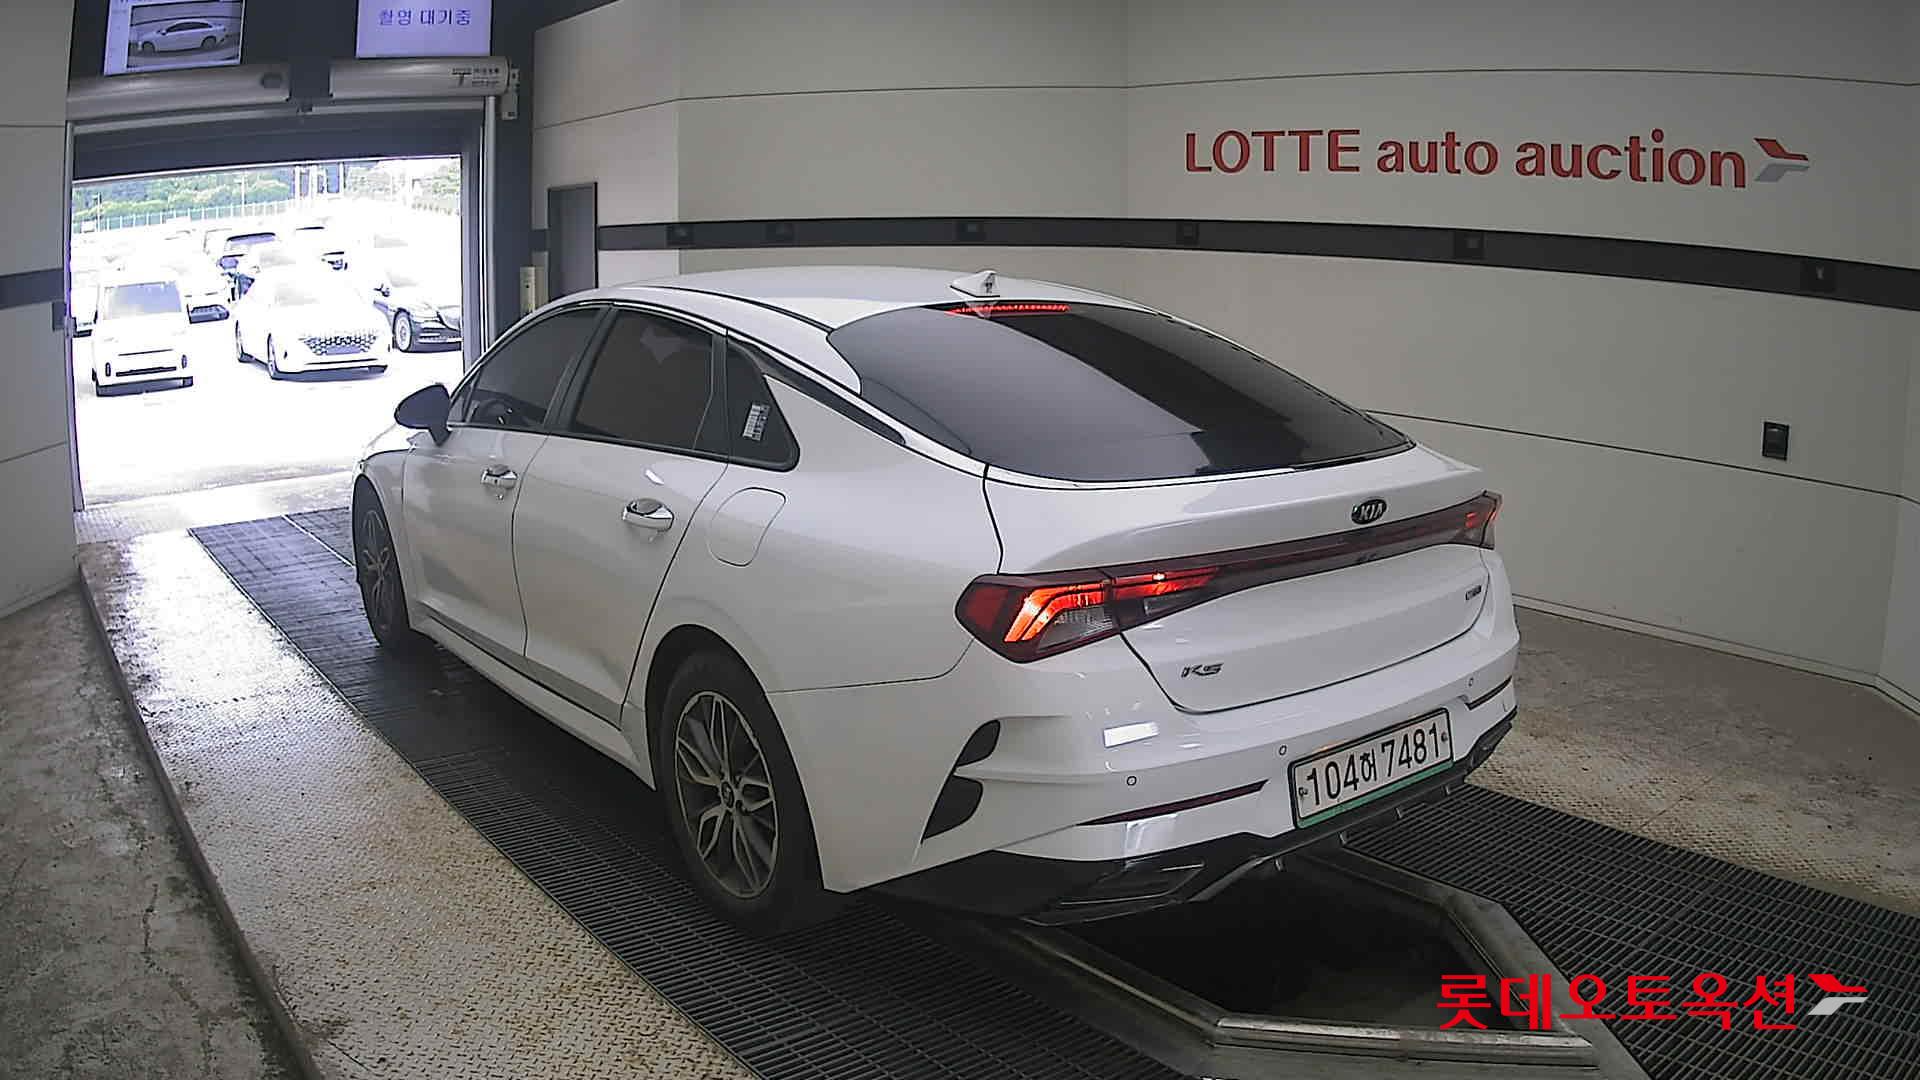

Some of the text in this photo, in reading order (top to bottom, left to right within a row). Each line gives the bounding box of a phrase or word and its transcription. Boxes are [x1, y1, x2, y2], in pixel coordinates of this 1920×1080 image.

[420, 8, 471, 26] 대기중
[1186, 129, 1746, 188] LOTTE auto auction
[1357, 502, 1385, 522] KIA
[1180, 663, 1224, 678] K5
